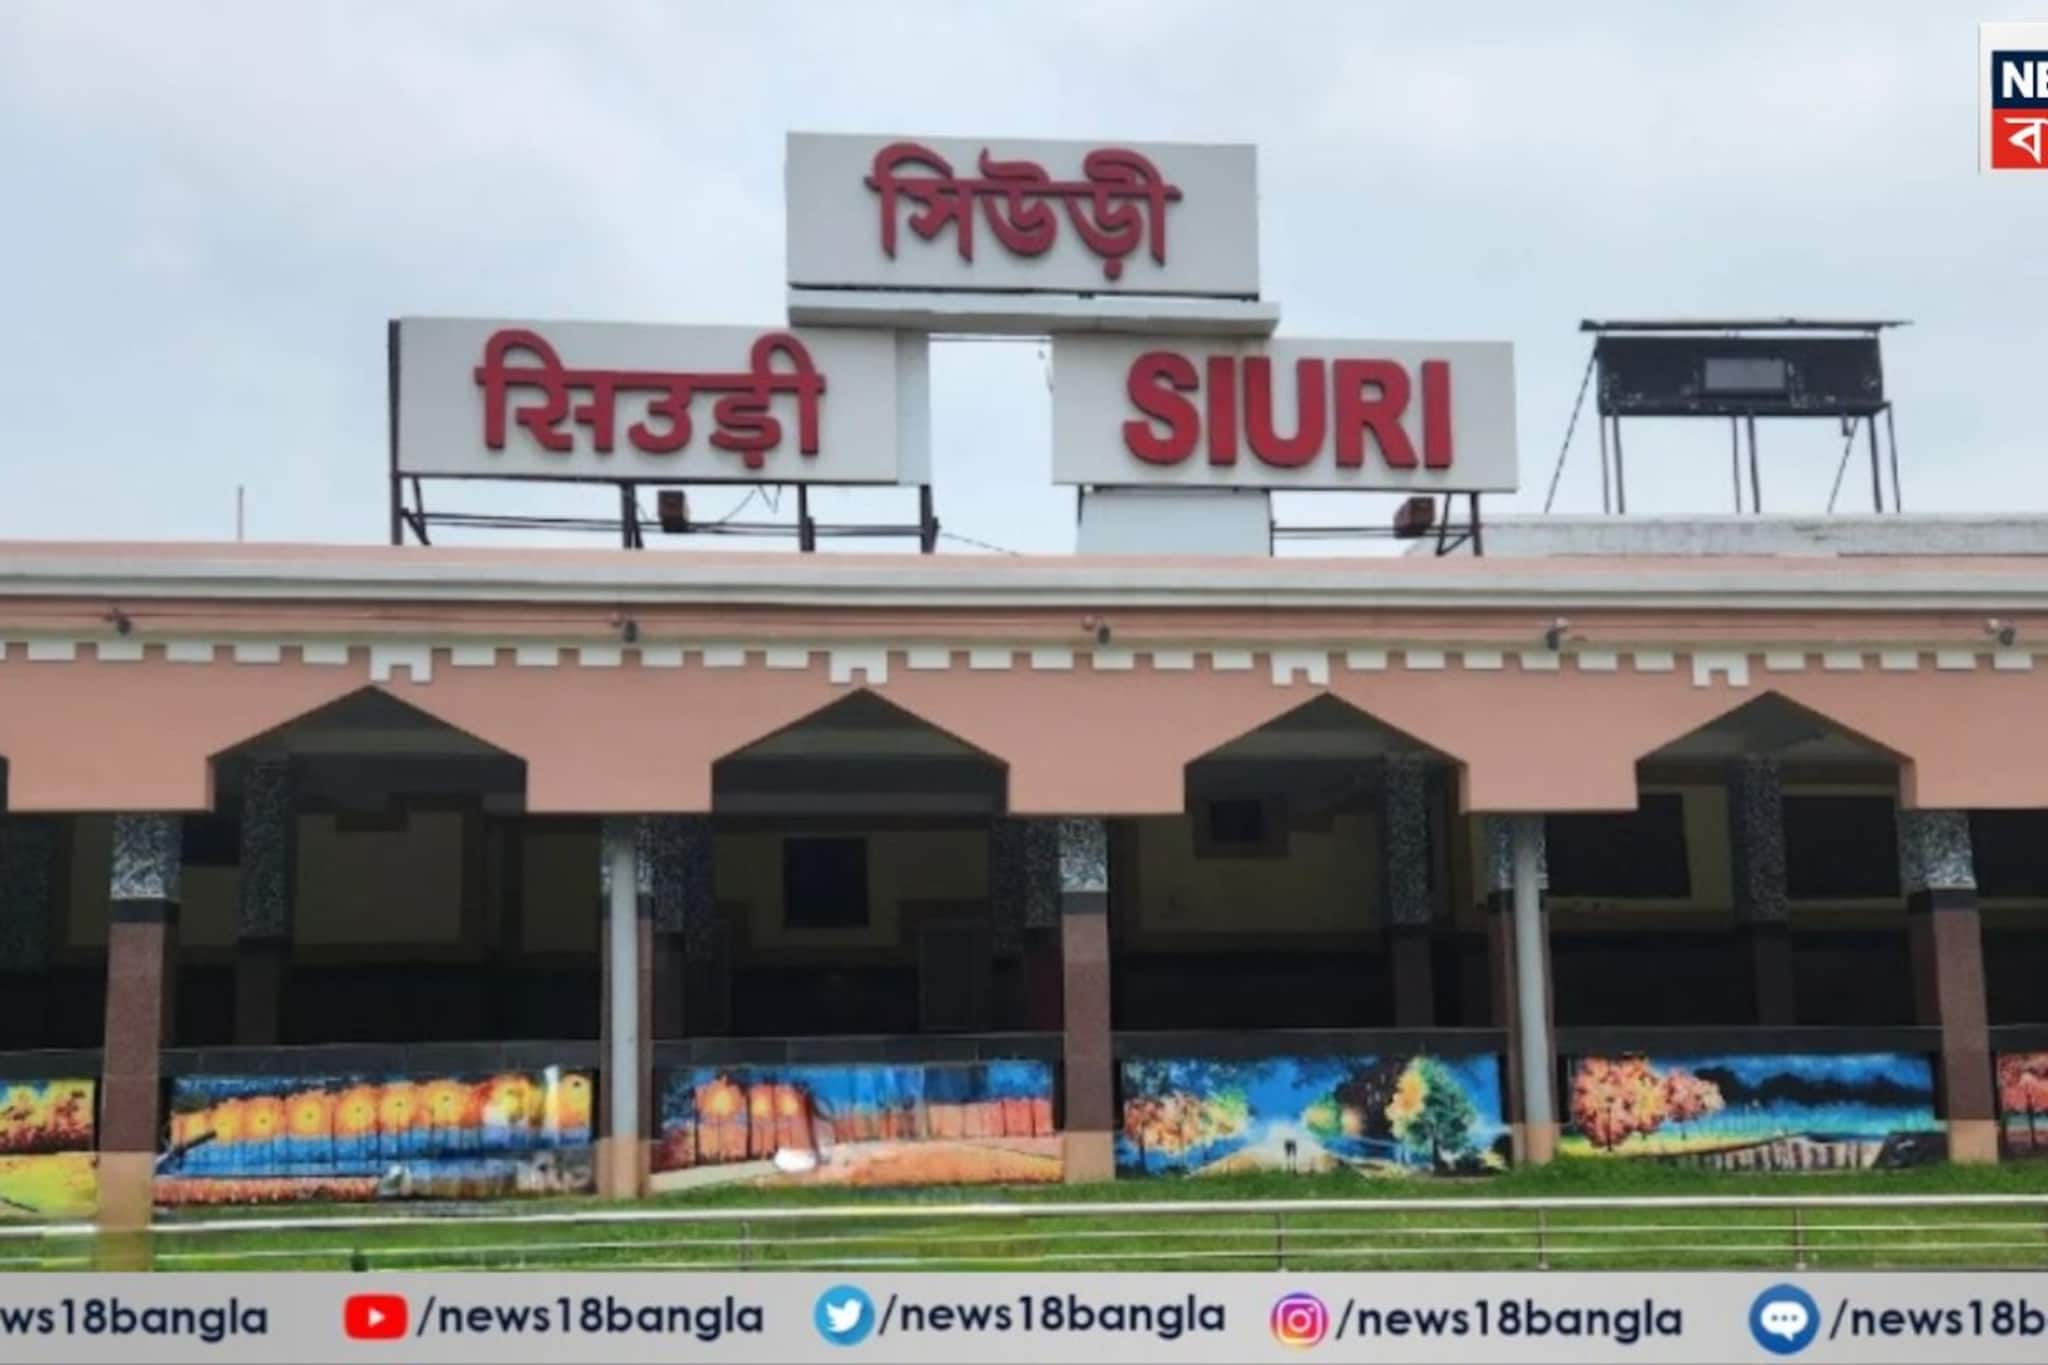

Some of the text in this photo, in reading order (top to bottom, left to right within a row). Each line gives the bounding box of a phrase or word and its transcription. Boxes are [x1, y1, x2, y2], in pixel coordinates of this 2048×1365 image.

[864, 143, 1183, 282] সিউড়ী
[474, 329, 827, 470] सिउड़ी
[1122, 351, 1454, 470] SIURI
